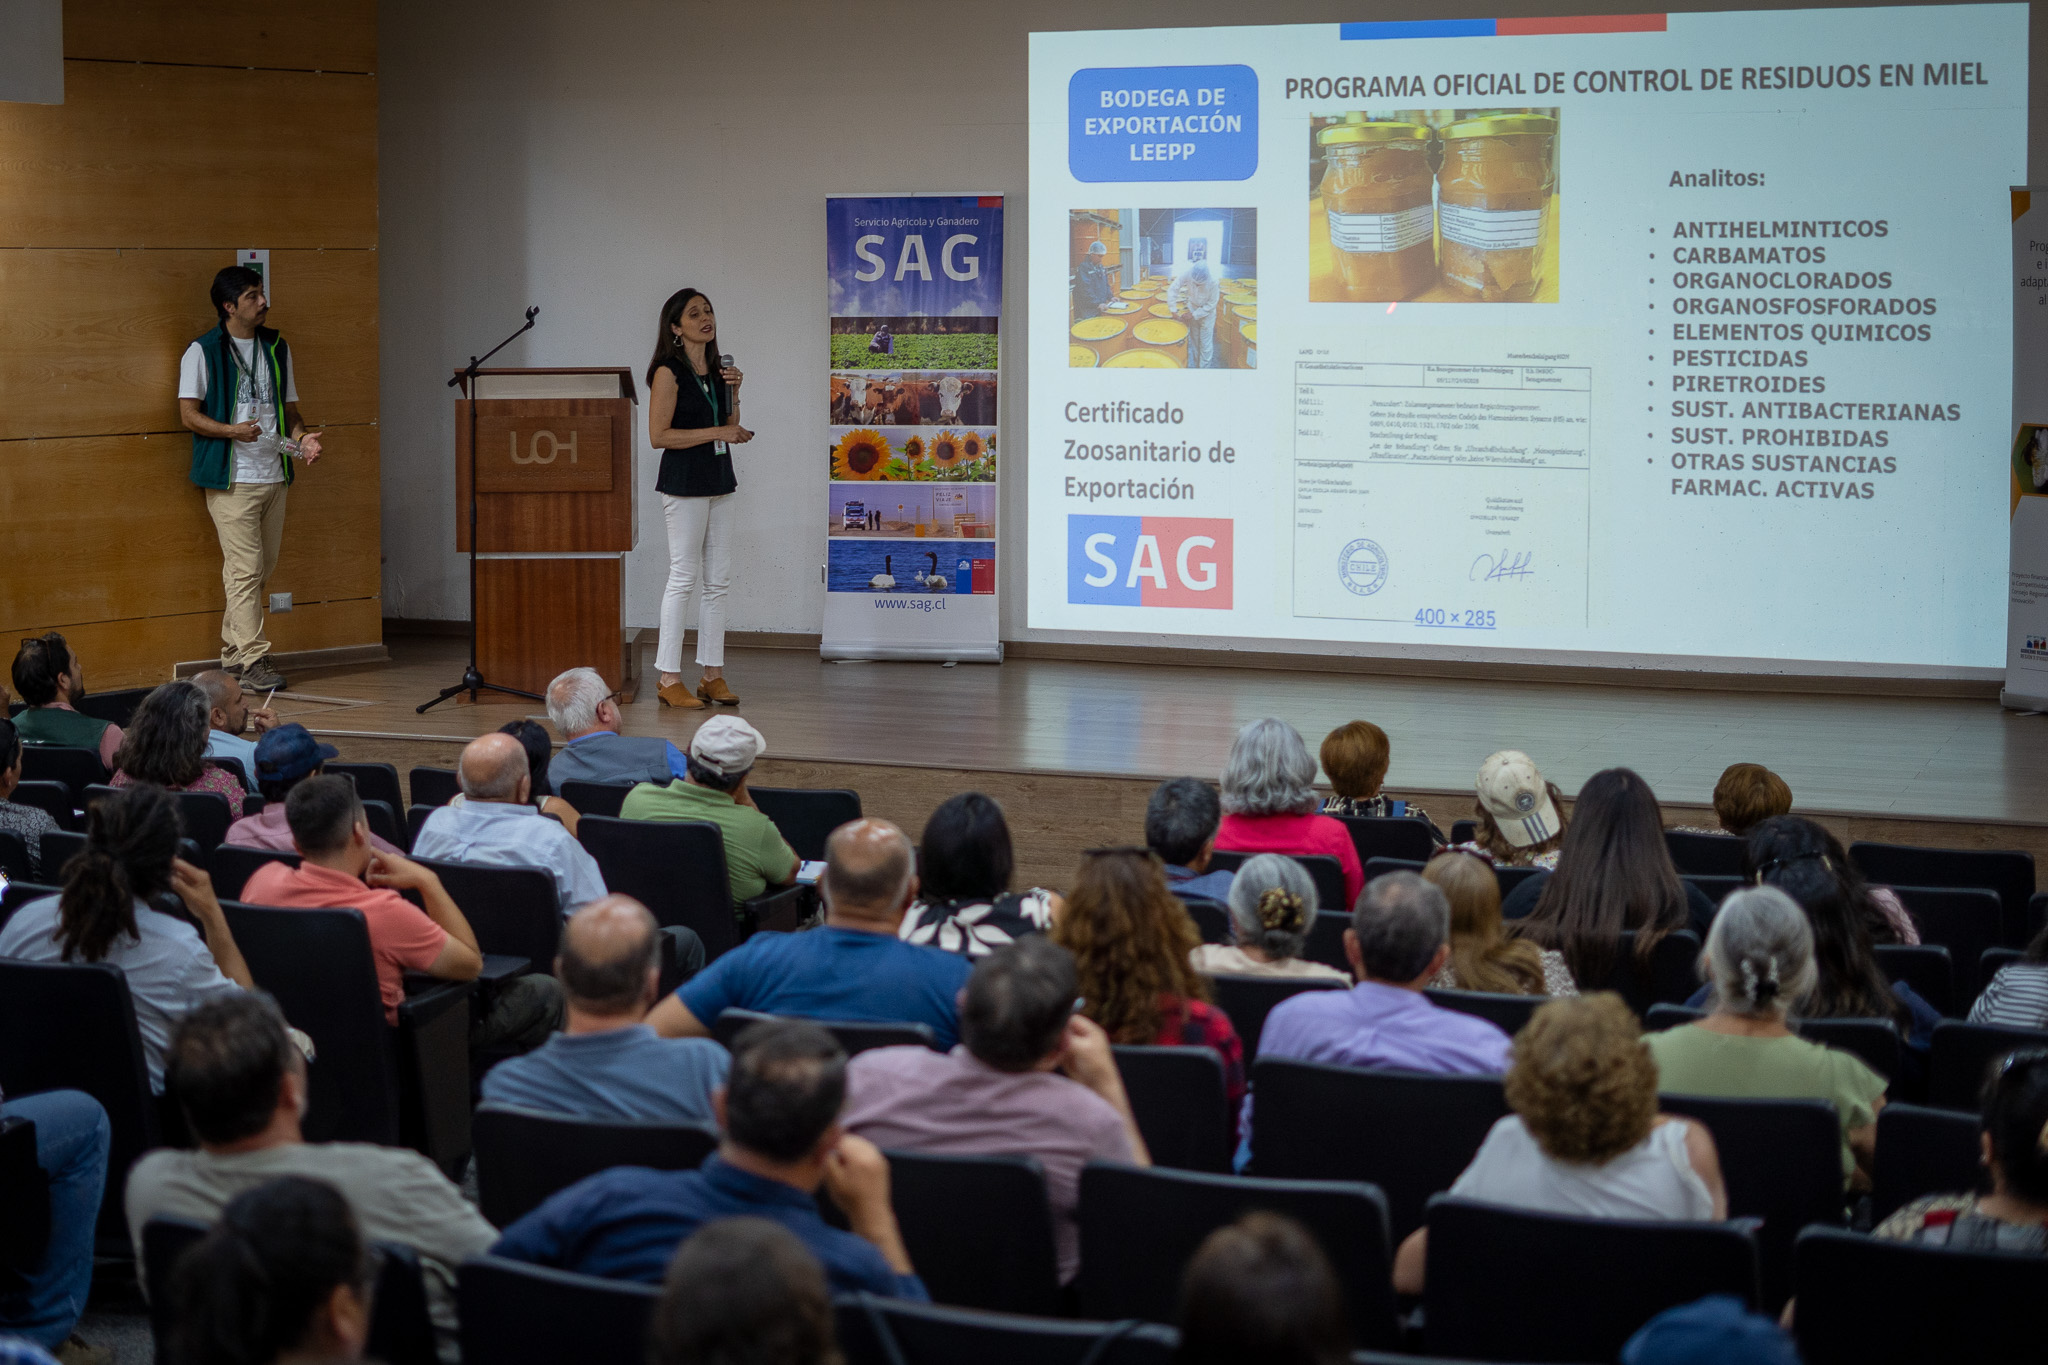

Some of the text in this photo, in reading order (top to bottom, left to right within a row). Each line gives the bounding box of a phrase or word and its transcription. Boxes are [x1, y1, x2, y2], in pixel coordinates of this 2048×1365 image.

[1285, 62, 1988, 99] PROGRAMA OFICIAL DE CONTROL DE RESIDUOS EN MIEL
[1100, 87, 1226, 108] BODEGA DE
[1084, 109, 1242, 136] EXPORTACIÓN
[1129, 143, 1195, 162] LEEPP
[1669, 169, 1766, 188] Analitos:
[854, 216, 979, 228] Servicio Agrícola y Ganadero
[1673, 220, 1889, 239] ANTIHELMINTICOS
[854, 233, 980, 282] SAG
[1673, 246, 1826, 264] CARBAMATOS
[2037, 260, 2042, 269] e
[1673, 271, 1893, 290] ORGANOCLORADOS
[2020, 276, 2048, 291] adapt
[1673, 297, 1937, 316] ORGANOSFOSFORADOS
[1673, 323, 1931, 344] ELEMENTOS QUIMICOS
[1672, 350, 1808, 367] PESTICIDAS
[1672, 375, 1826, 393] PIRETROIDES
[1065, 400, 1184, 424] Certificado
[1671, 401, 1961, 422] SUST. ANTIBACTERIANAS
[1671, 427, 1889, 447] SUST. PROHIBIDAS
[510, 430, 578, 465] UOH
[1064, 440, 1236, 463] Zoosanitario de
[1671, 453, 1897, 474] OTRAS SUSTANCIAS
[1065, 476, 1194, 502] Exportación
[1671, 478, 1875, 499] FARMAC. ACTIVAS
[1084, 532, 1218, 591] SAG
[1350, 563, 1376, 572] CHILE
[875, 597, 946, 612] www.sag.cl
[1415, 608, 1445, 625] 400
[1465, 610, 1496, 627] 285
